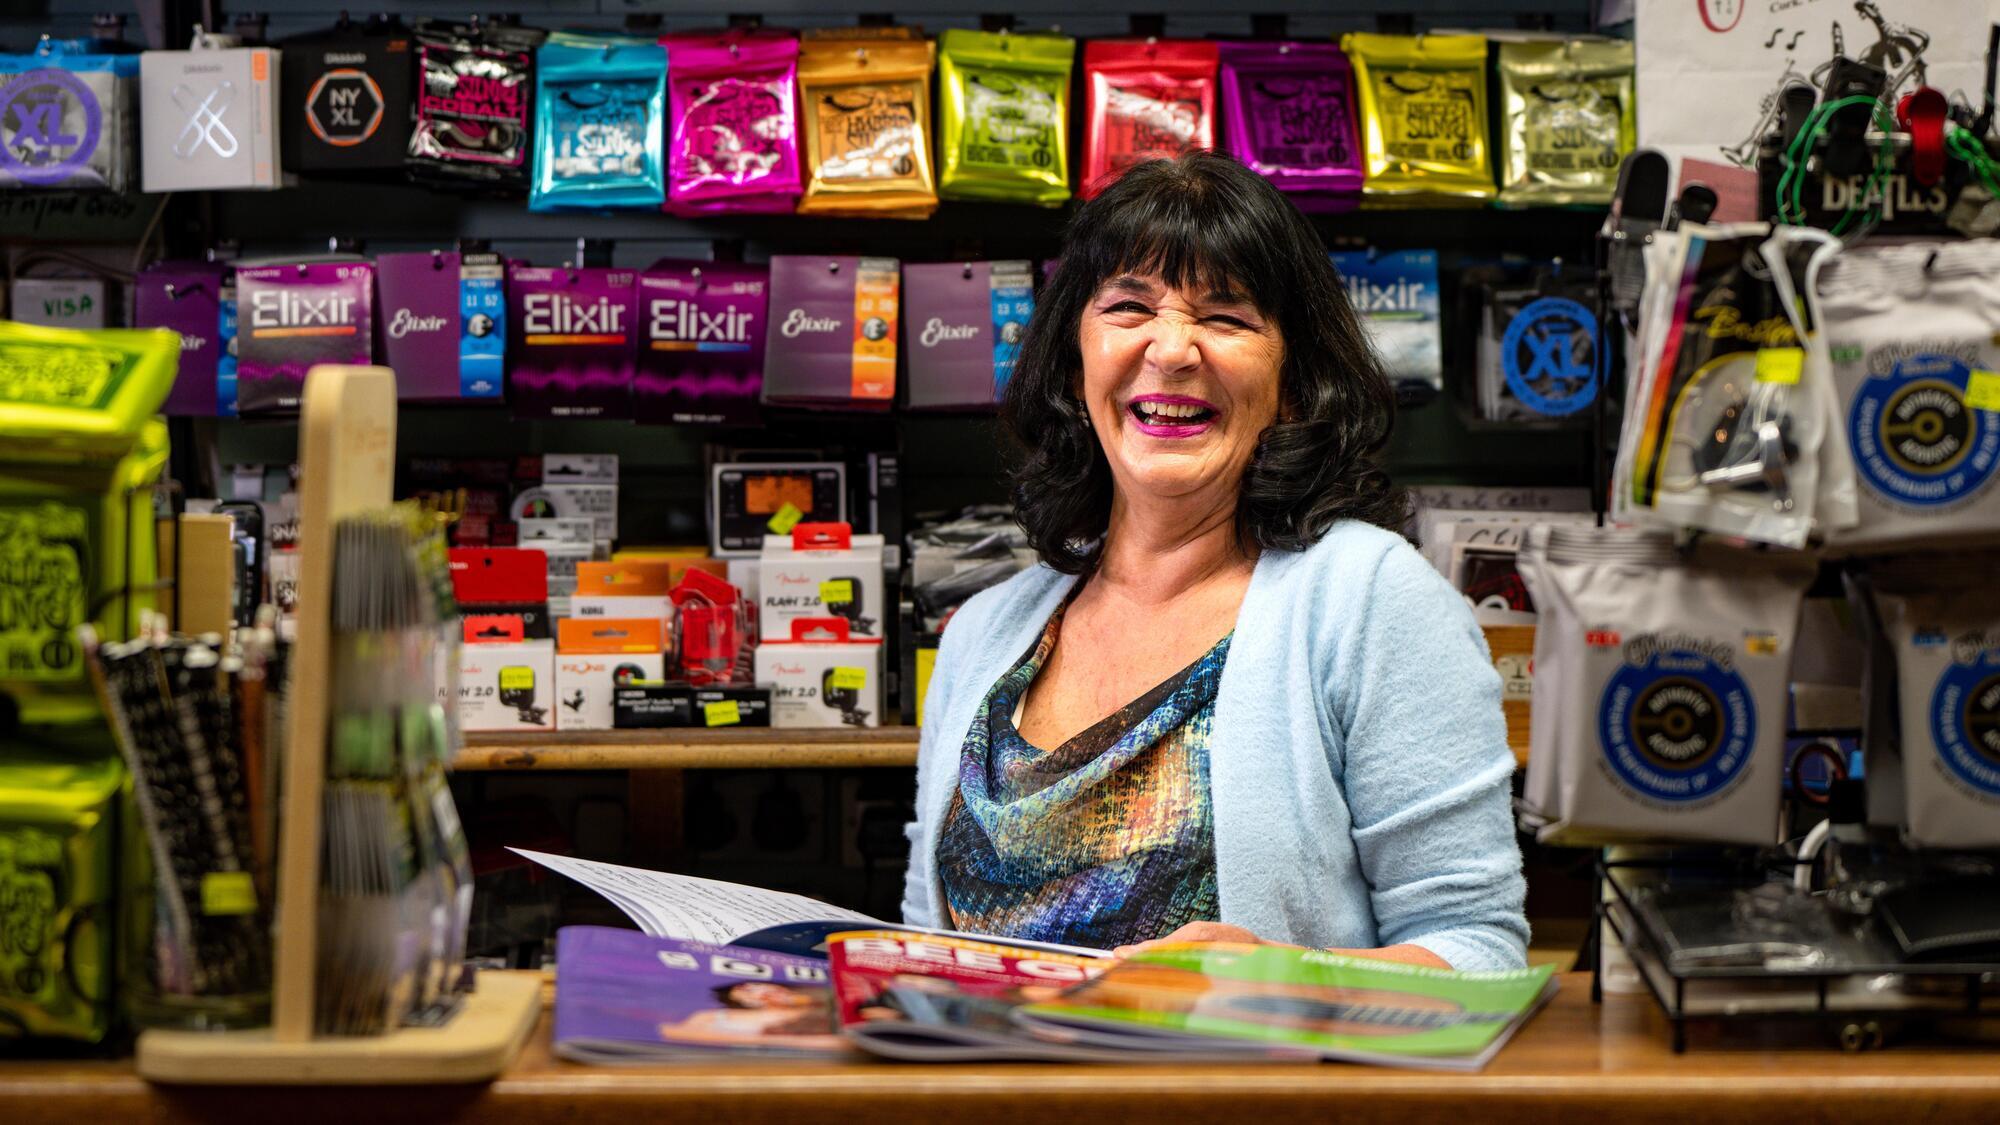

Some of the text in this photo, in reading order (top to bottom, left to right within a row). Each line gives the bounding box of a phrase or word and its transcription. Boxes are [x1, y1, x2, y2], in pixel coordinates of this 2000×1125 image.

[330, 88, 360, 106] NY
[10, 103, 78, 146] XL
[331, 108, 360, 126] XL
[252, 290, 356, 327] Elixir
[1344, 275, 1424, 310] lixir
[388, 308, 448, 338] Elixir
[523, 294, 626, 333] Elixir
[650, 299, 753, 341] Elixir
[781, 308, 842, 338] Elixir
[920, 317, 980, 347] Elixir
[1523, 333, 1591, 380] XL
[473, 686, 494, 697] 2.0
[798, 686, 817, 697] 2.0
[844, 937, 1006, 973] BEE
